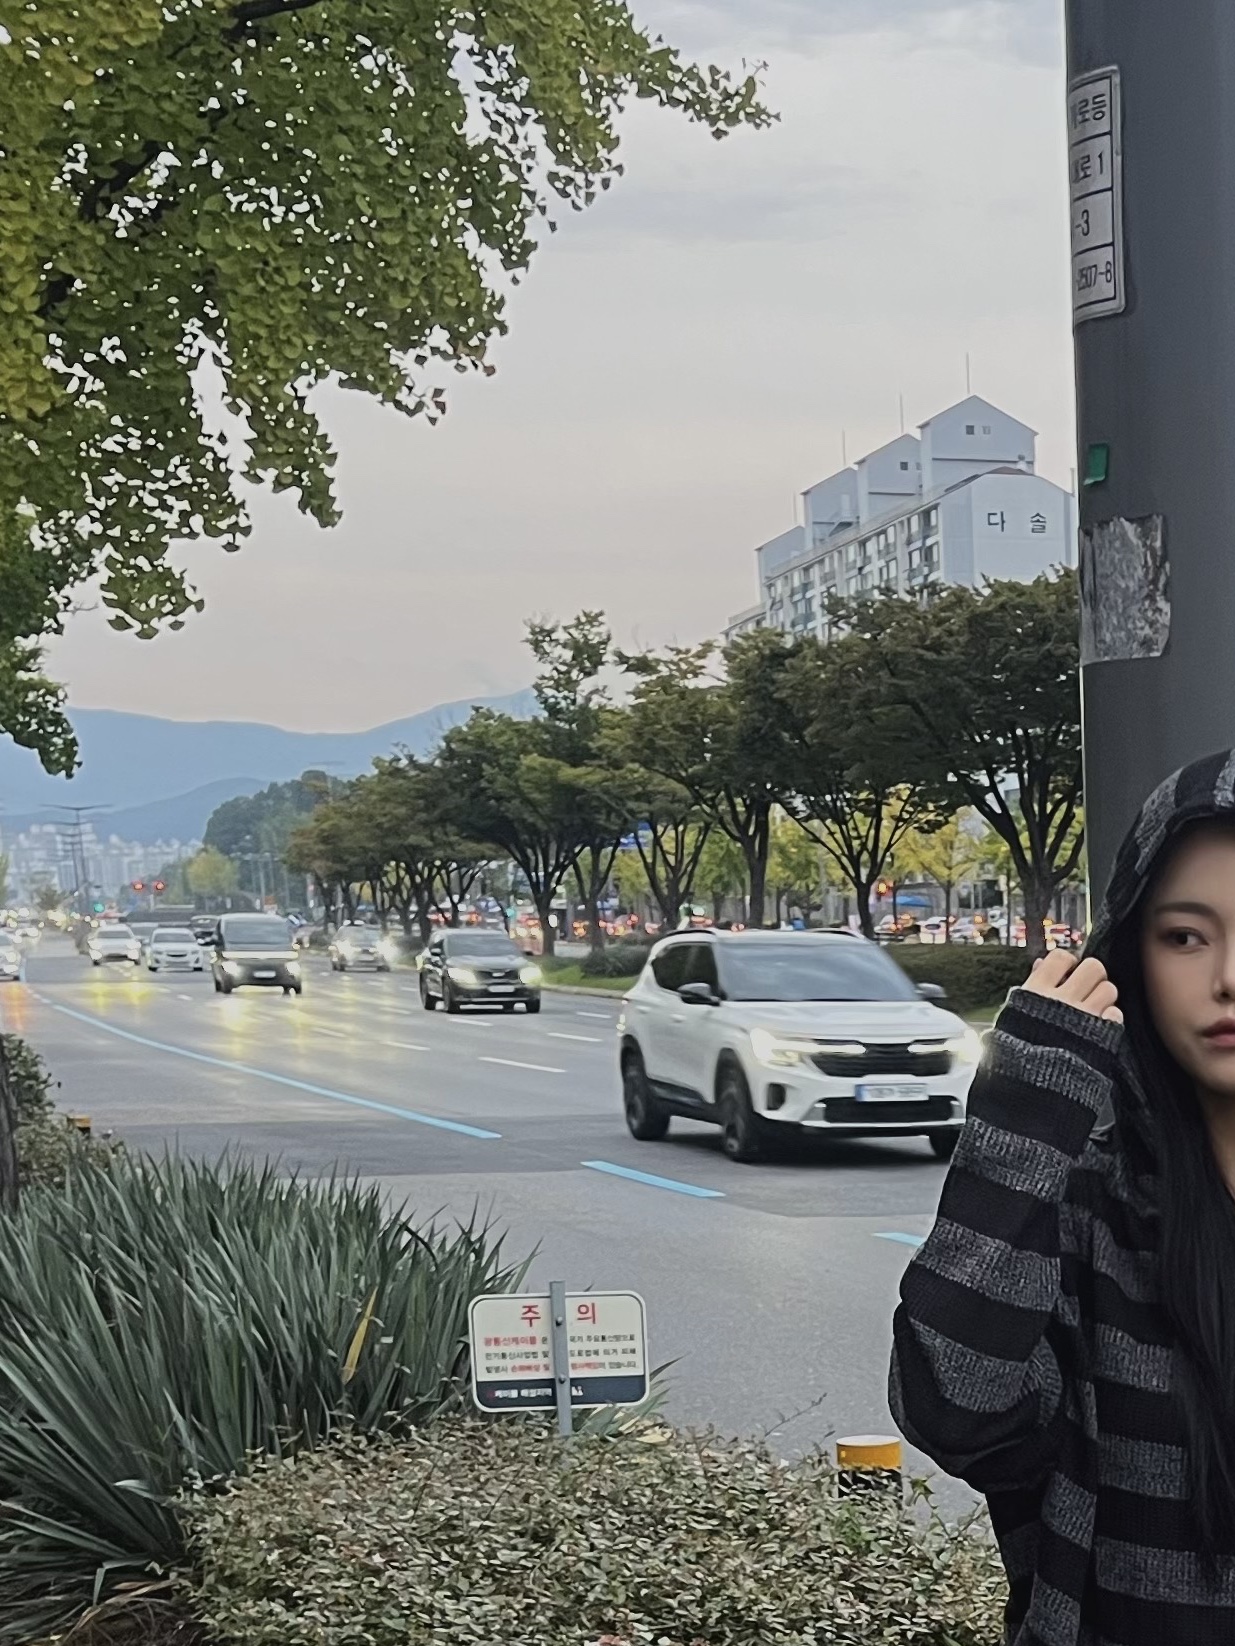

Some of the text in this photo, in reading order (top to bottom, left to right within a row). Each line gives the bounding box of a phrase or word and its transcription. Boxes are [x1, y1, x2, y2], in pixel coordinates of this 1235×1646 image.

[986, 510, 1006, 533] 다
[521, 1303, 596, 1327] 주 의
